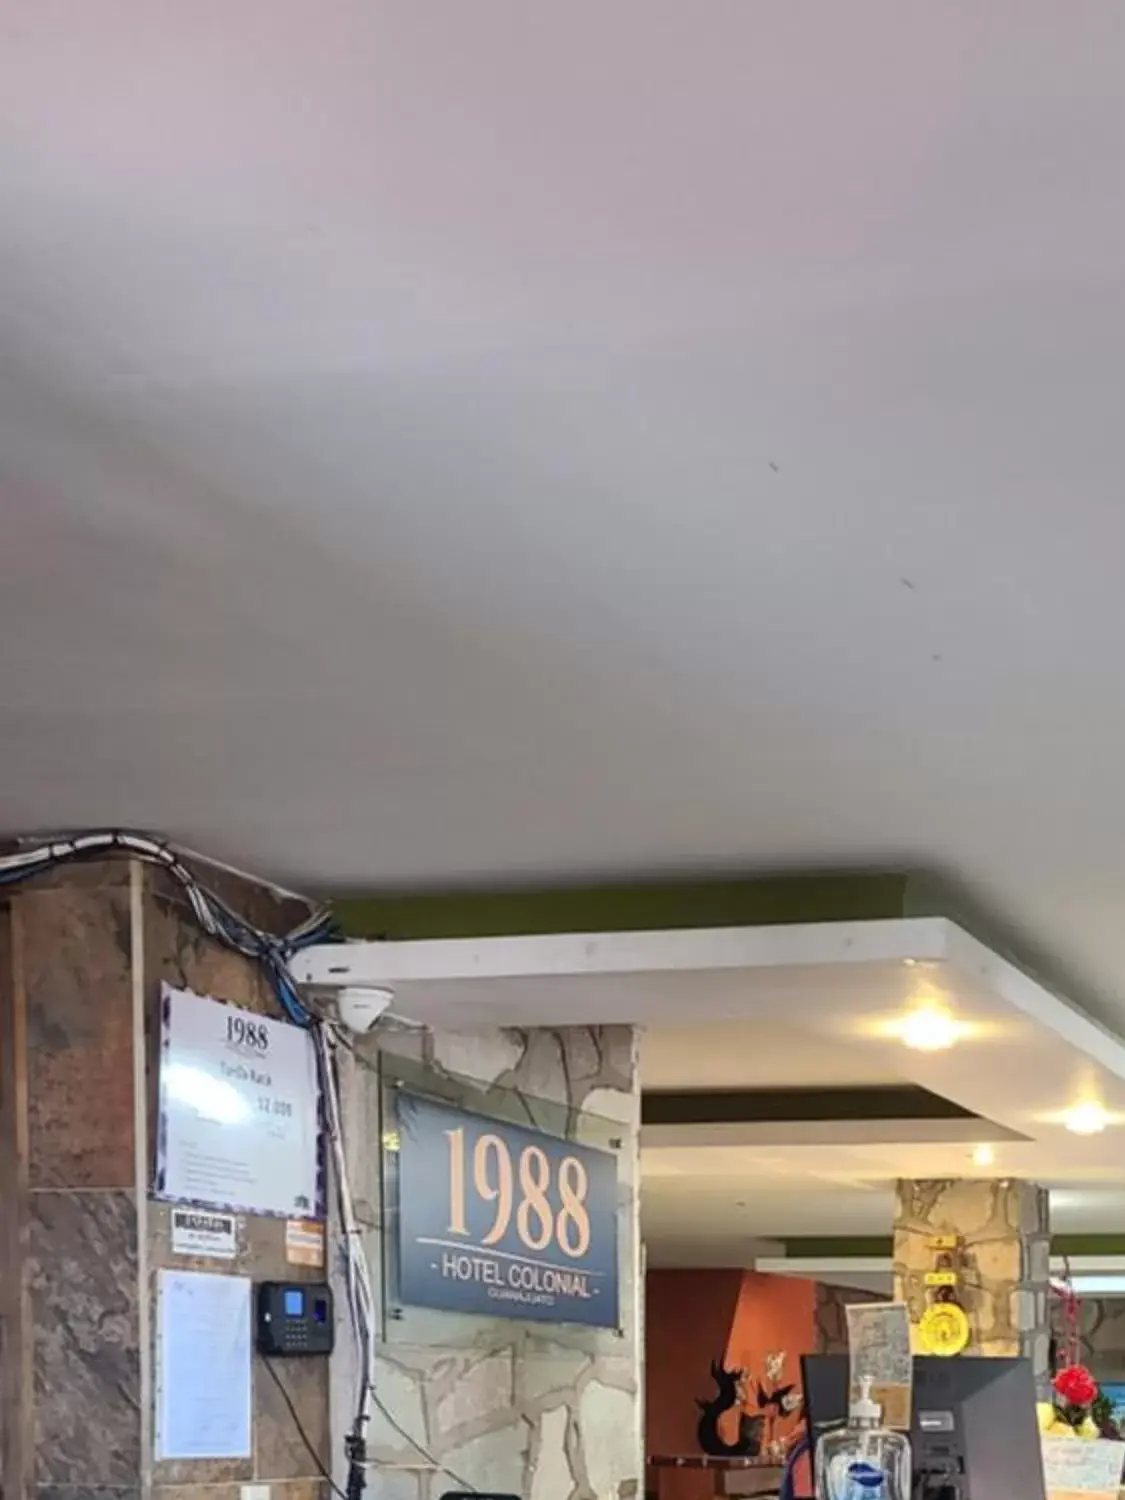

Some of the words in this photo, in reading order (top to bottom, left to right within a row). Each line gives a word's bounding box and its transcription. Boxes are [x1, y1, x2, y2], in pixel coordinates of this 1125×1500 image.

[227, 1015, 270, 1050] 1988
[444, 1125, 590, 1258] 1988
[442, 1254, 505, 1286] HOTEL
[508, 1265, 592, 1298] COLONIAL
